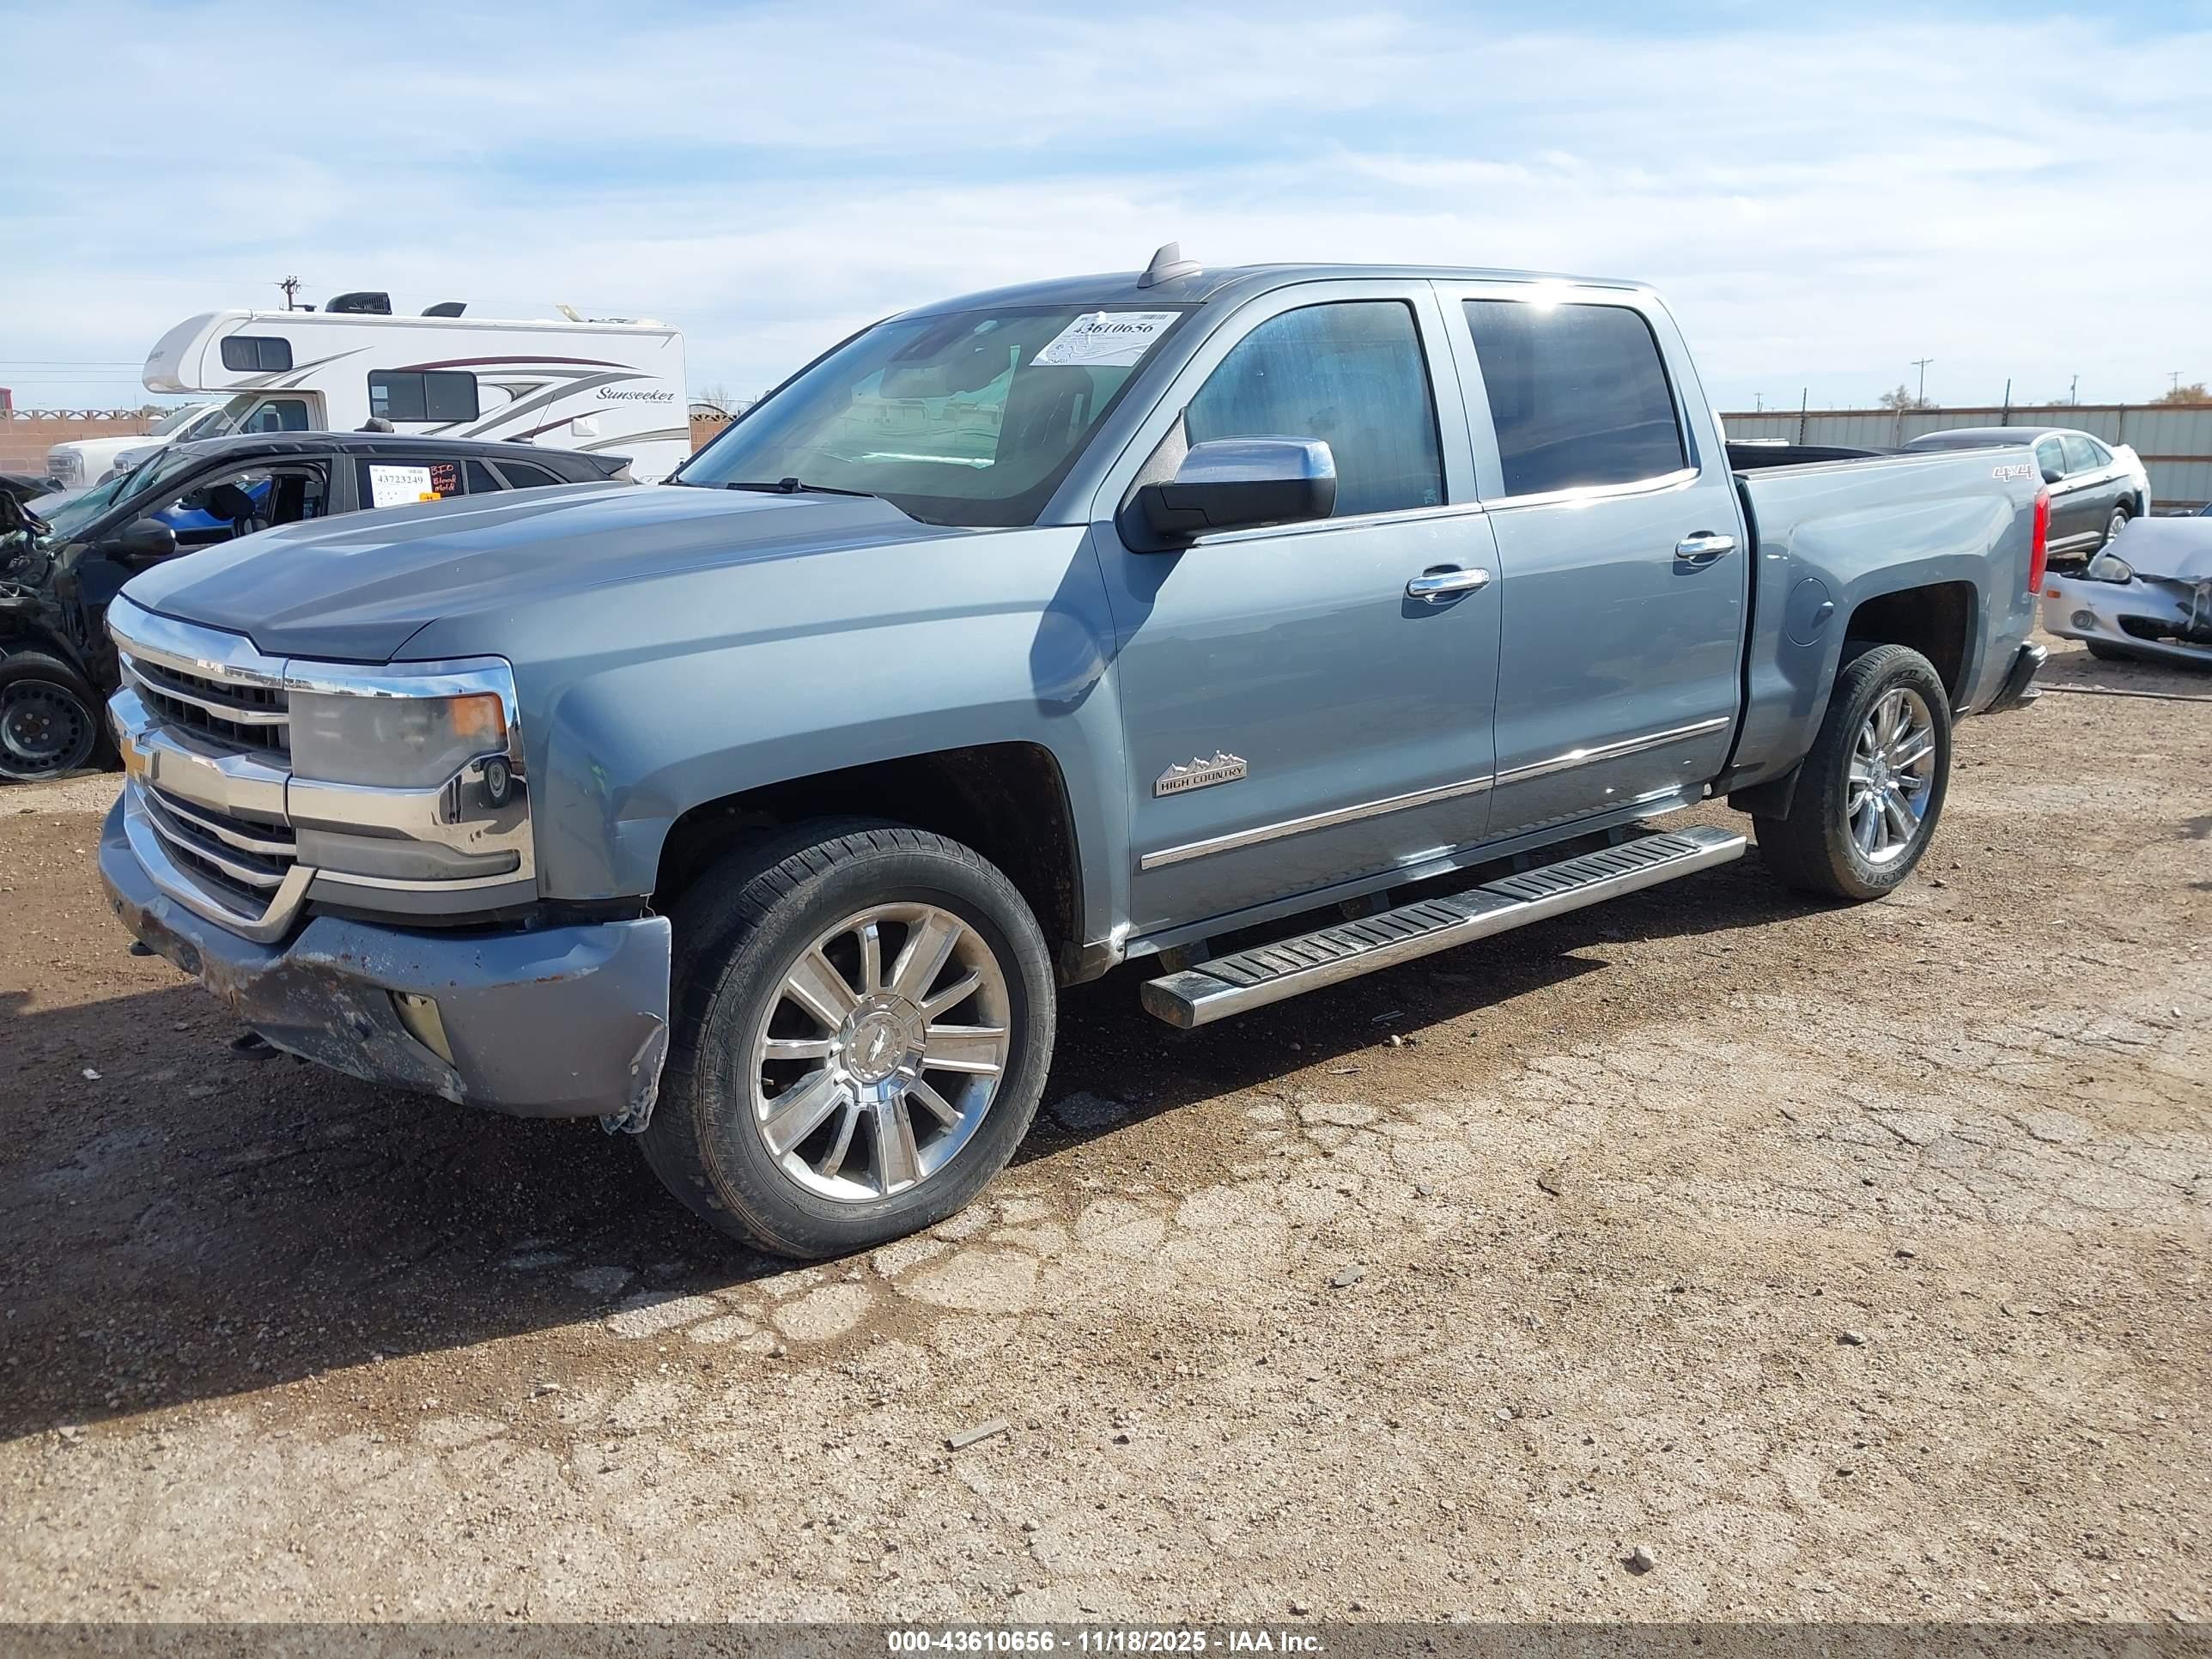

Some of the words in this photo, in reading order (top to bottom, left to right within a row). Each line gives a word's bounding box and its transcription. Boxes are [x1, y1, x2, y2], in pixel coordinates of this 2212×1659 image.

[596, 386, 675, 400] Sunseeker
[378, 475, 423, 483] 43723249
[1161, 778, 1189, 791] HIGH
[1194, 766, 1244, 784] COUNTRY
